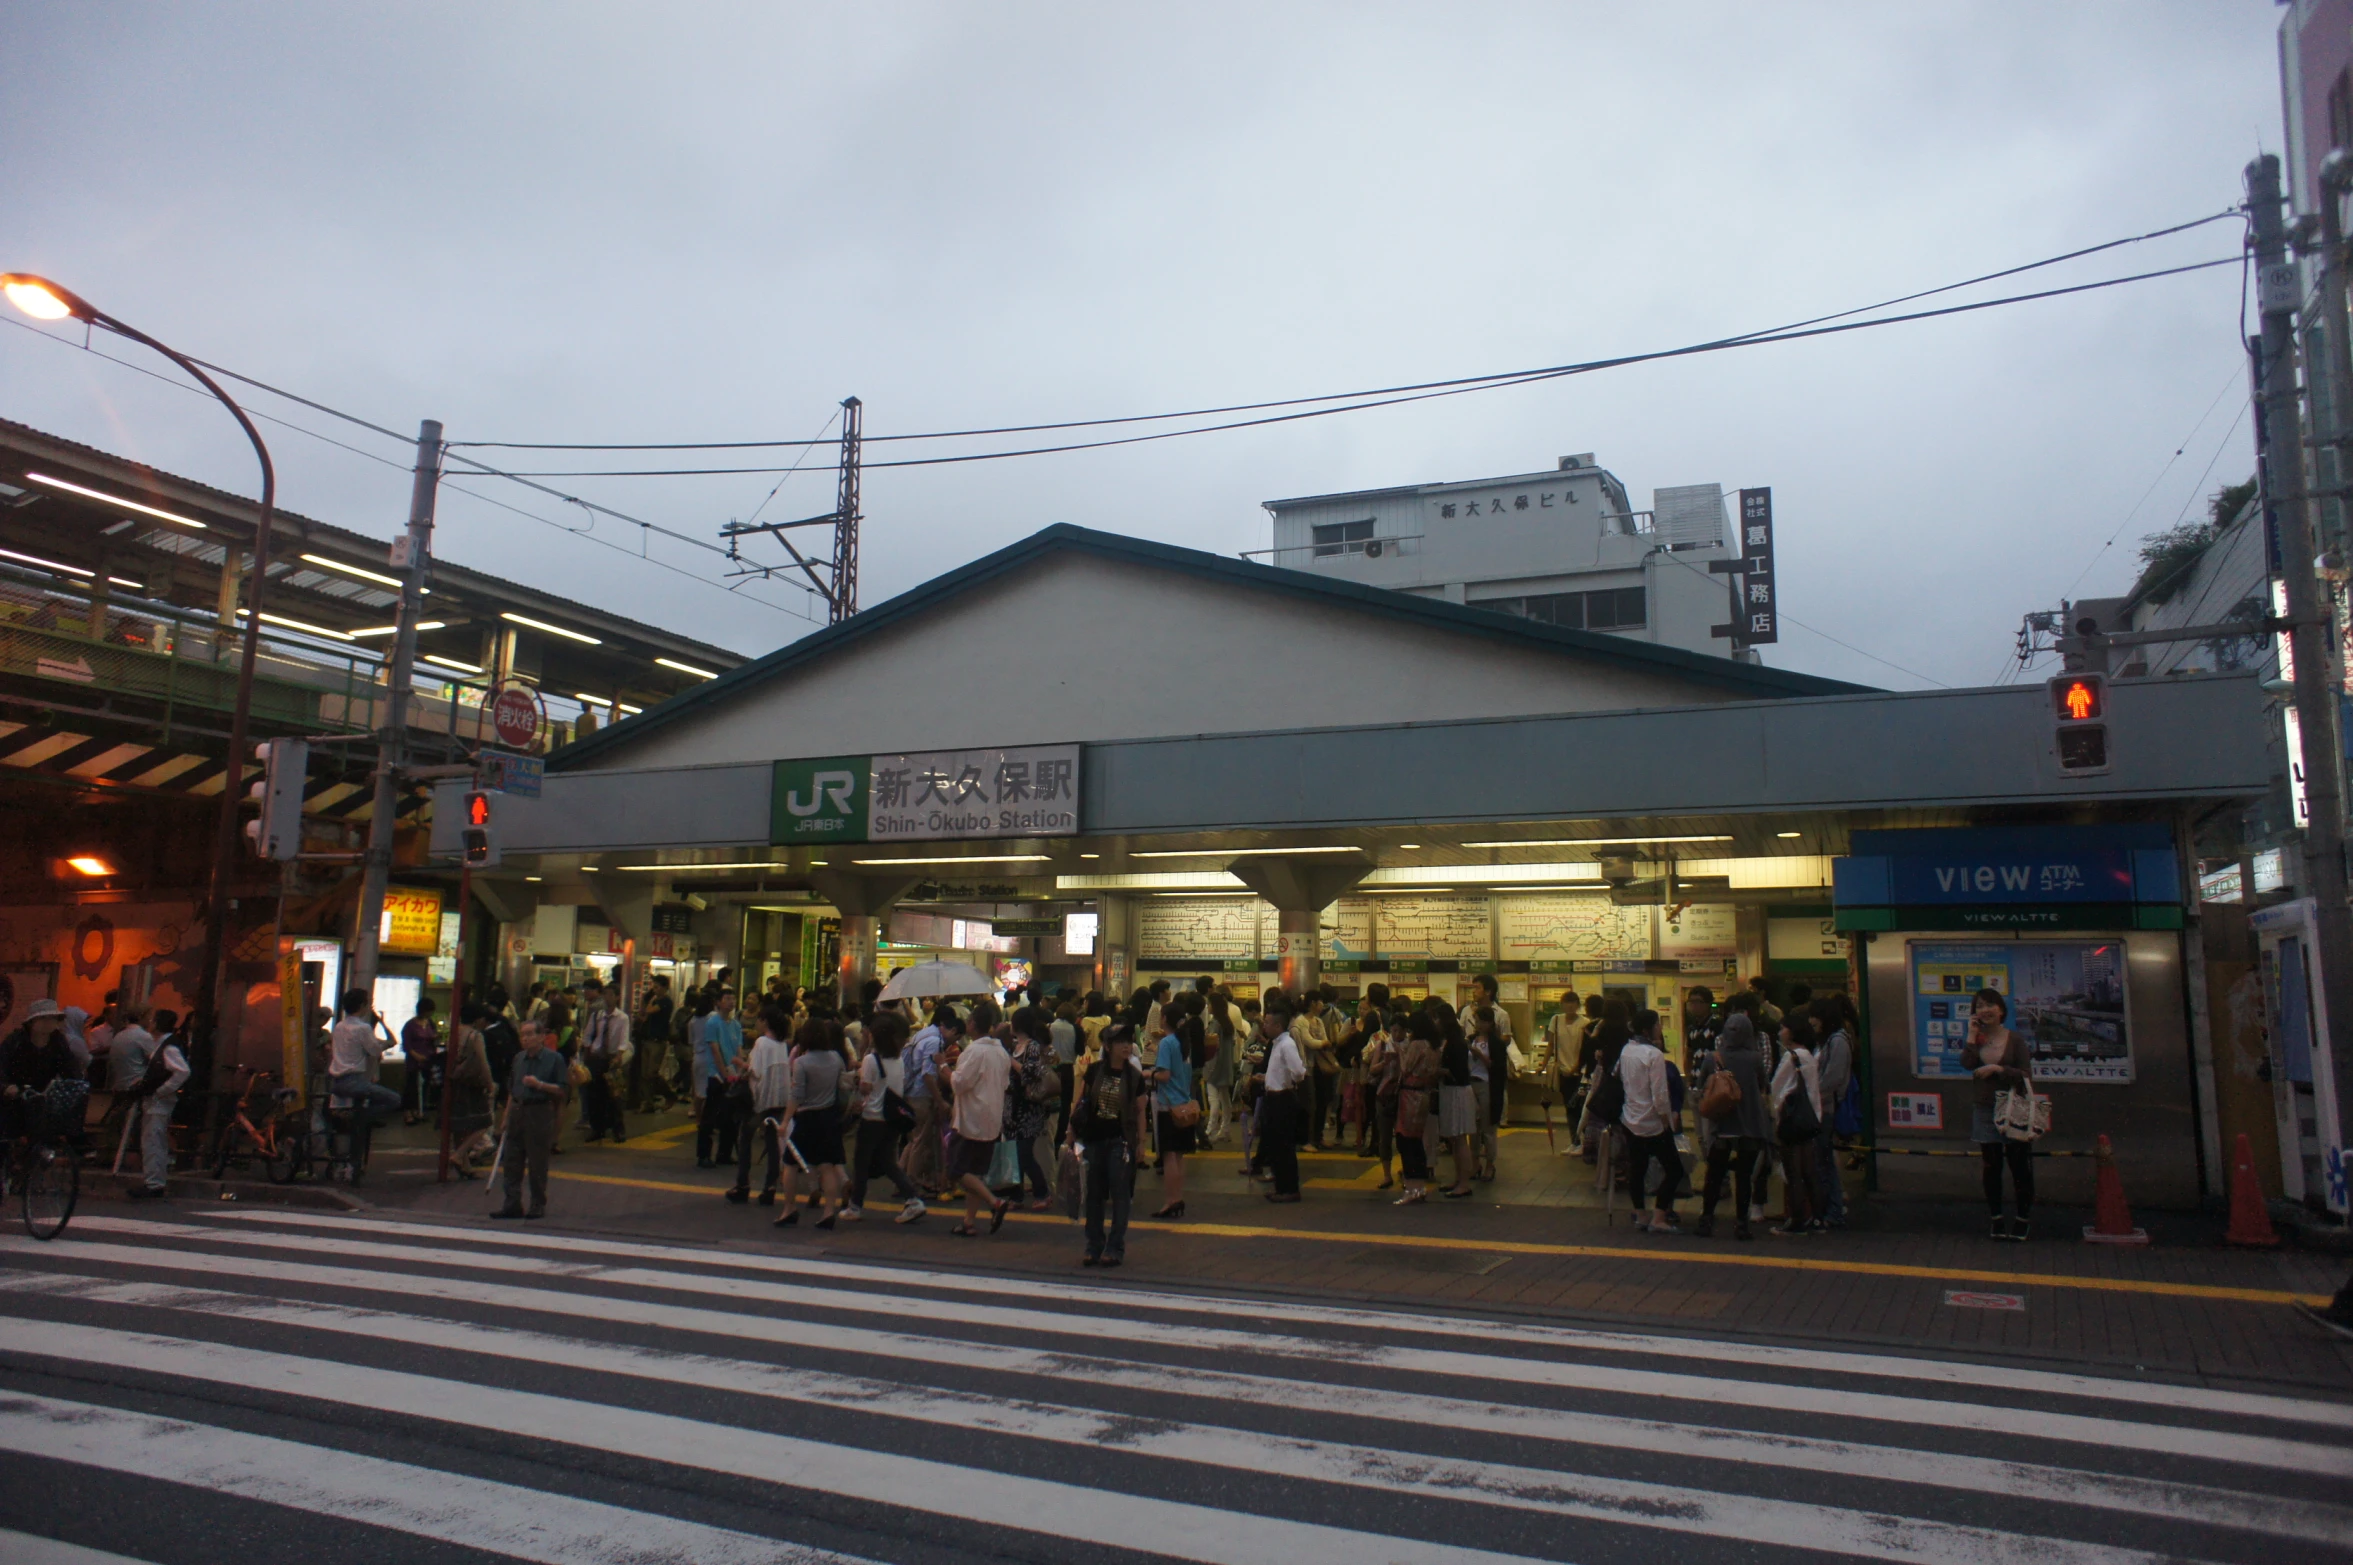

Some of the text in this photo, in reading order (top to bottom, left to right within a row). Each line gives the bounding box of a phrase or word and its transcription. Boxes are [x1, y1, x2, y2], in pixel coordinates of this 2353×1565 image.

[1441, 490, 1579, 519] 新大久保ビル
[1746, 525, 1771, 633] 葛工務店
[498, 703, 535, 732] 消火栓
[787, 770, 855, 817] JR
[875, 758, 1073, 809] 新大久保駅
[794, 818, 845, 832] JR東日本
[874, 809, 1072, 835] Shin-Ōkubo Station
[2041, 865, 2080, 879] ATM
[2040, 880, 2084, 891] コーナー
[383, 895, 439, 914] アイカワ
[1964, 913, 2058, 922] VIEW ALTTE
[2033, 1067, 2129, 1078] IEW ALTTE
